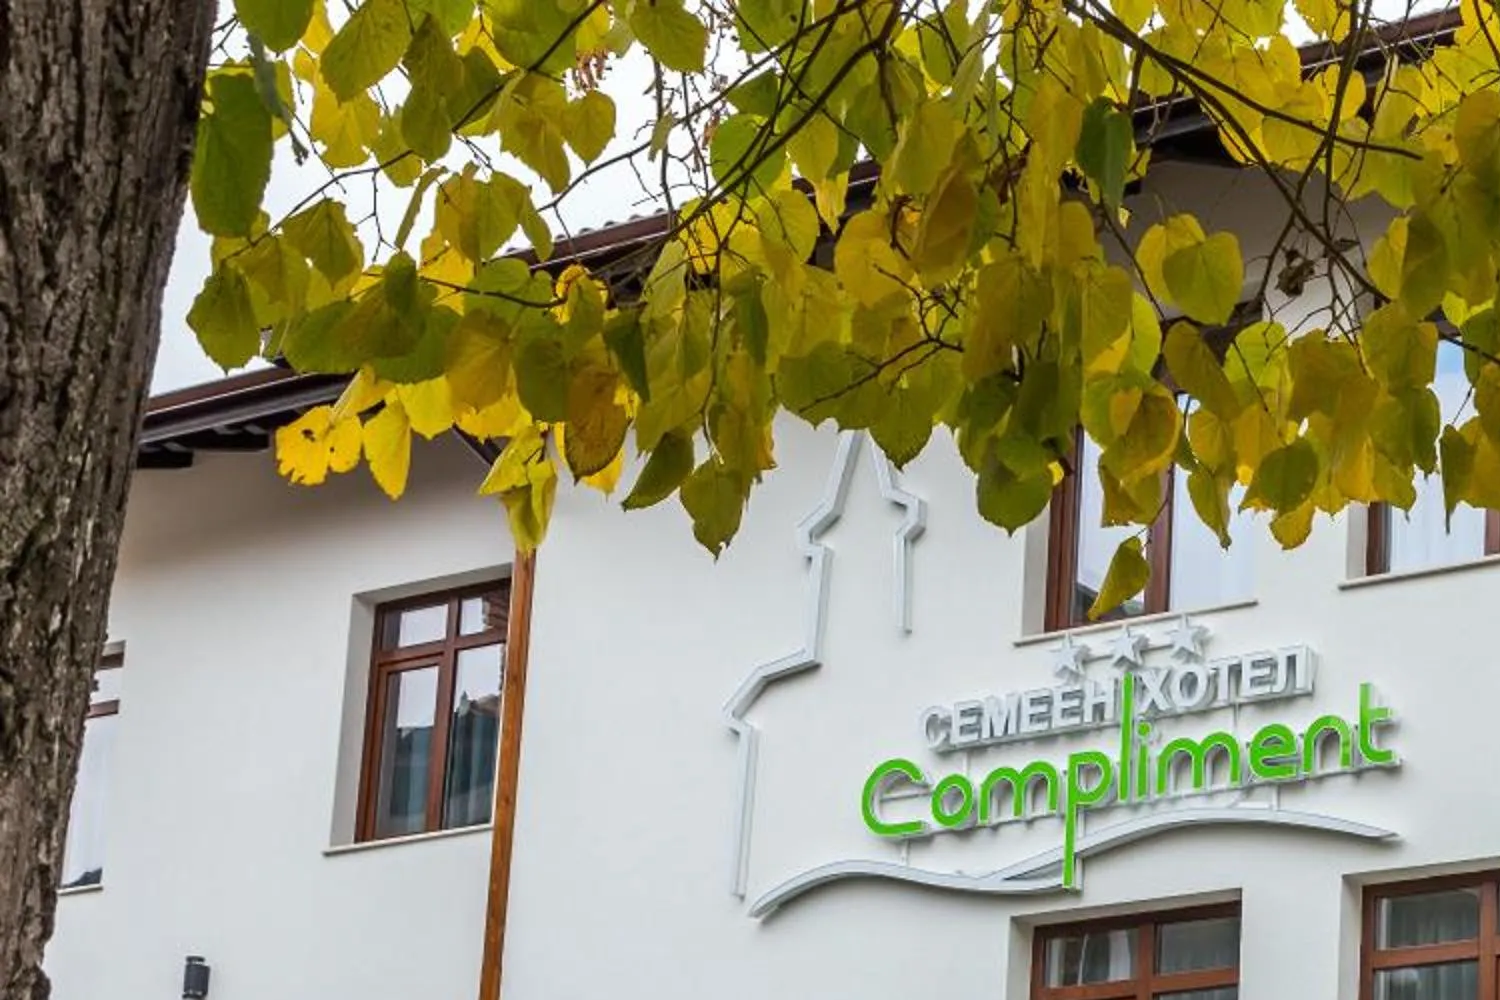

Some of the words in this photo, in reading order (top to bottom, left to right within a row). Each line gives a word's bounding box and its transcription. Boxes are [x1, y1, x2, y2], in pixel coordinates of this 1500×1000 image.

[921, 678, 1117, 752] СЕМЕЕН
[1138, 644, 1314, 713] ХОТЕЛ
[861, 672, 1394, 888] Compliment
